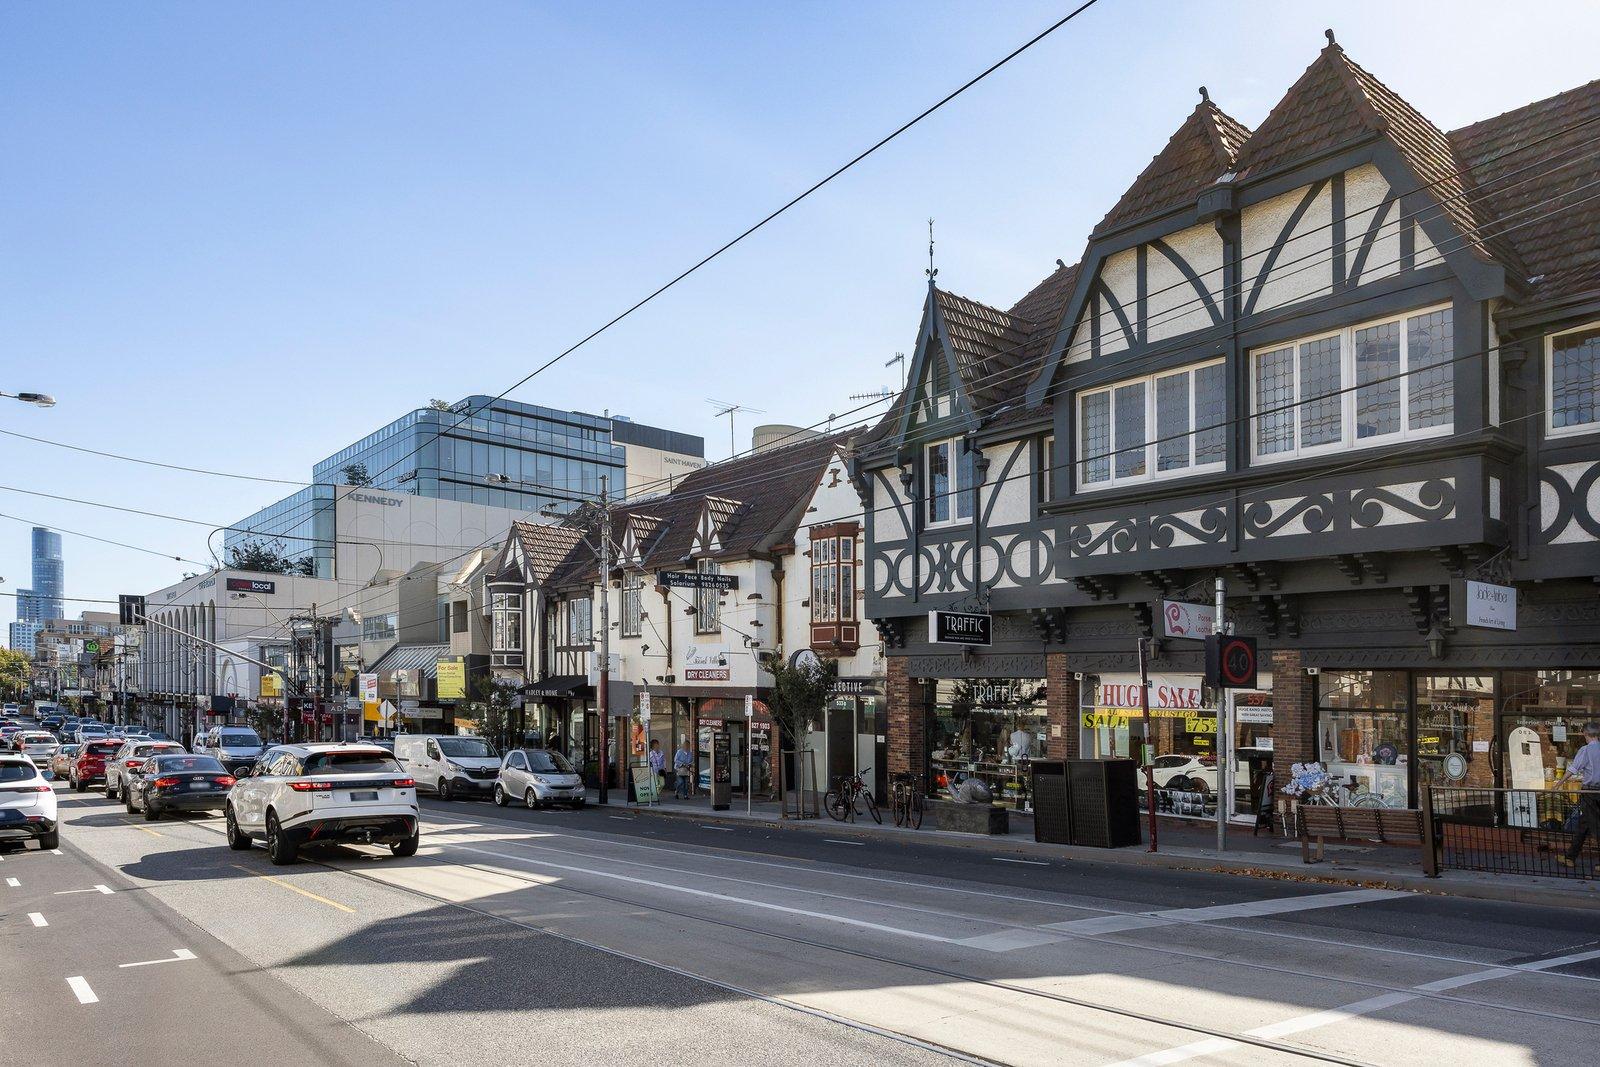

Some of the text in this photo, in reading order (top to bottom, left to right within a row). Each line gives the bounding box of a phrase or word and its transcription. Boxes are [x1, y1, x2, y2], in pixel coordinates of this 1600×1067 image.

[664, 457, 702, 469] SAINT HAVEN
[347, 493, 403, 507] KENNEDY
[252, 581, 271, 590] local
[945, 616, 983, 633] TRAFFIC
[1229, 652, 1248, 671] 40
[687, 671, 727, 679] DRY CLEANERS
[973, 685, 1020, 703] TRAFFIC
[1158, 686, 1200, 709] SALE
[1084, 714, 1129, 729] SALE
